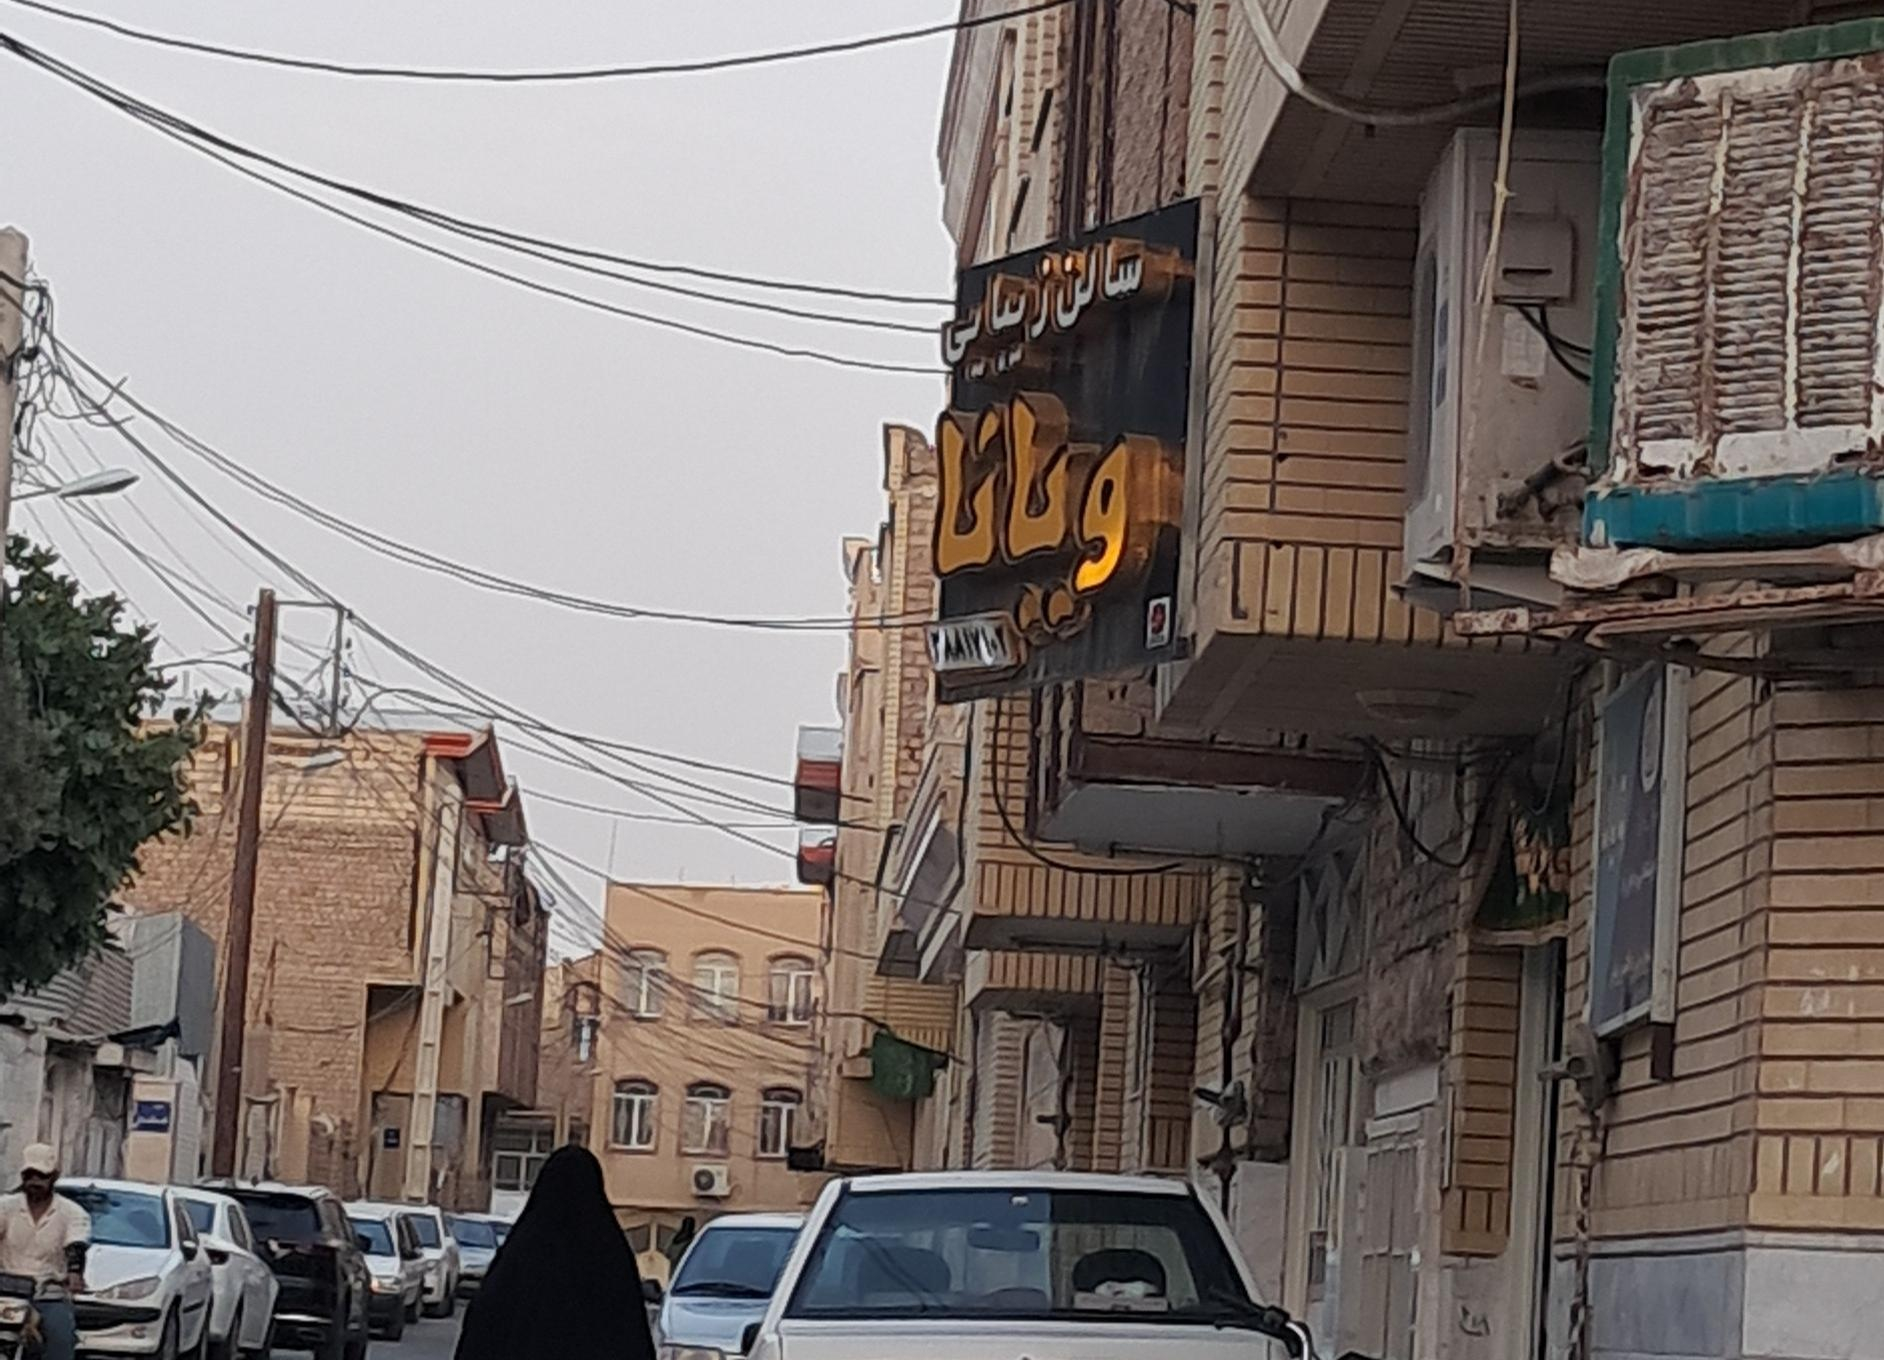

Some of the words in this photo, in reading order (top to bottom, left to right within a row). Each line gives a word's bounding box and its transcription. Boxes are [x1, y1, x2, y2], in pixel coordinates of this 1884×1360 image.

[944, 256, 1049, 378] زیبایی
[1055, 243, 1146, 329] سالن
[933, 394, 1129, 628] ویانا
